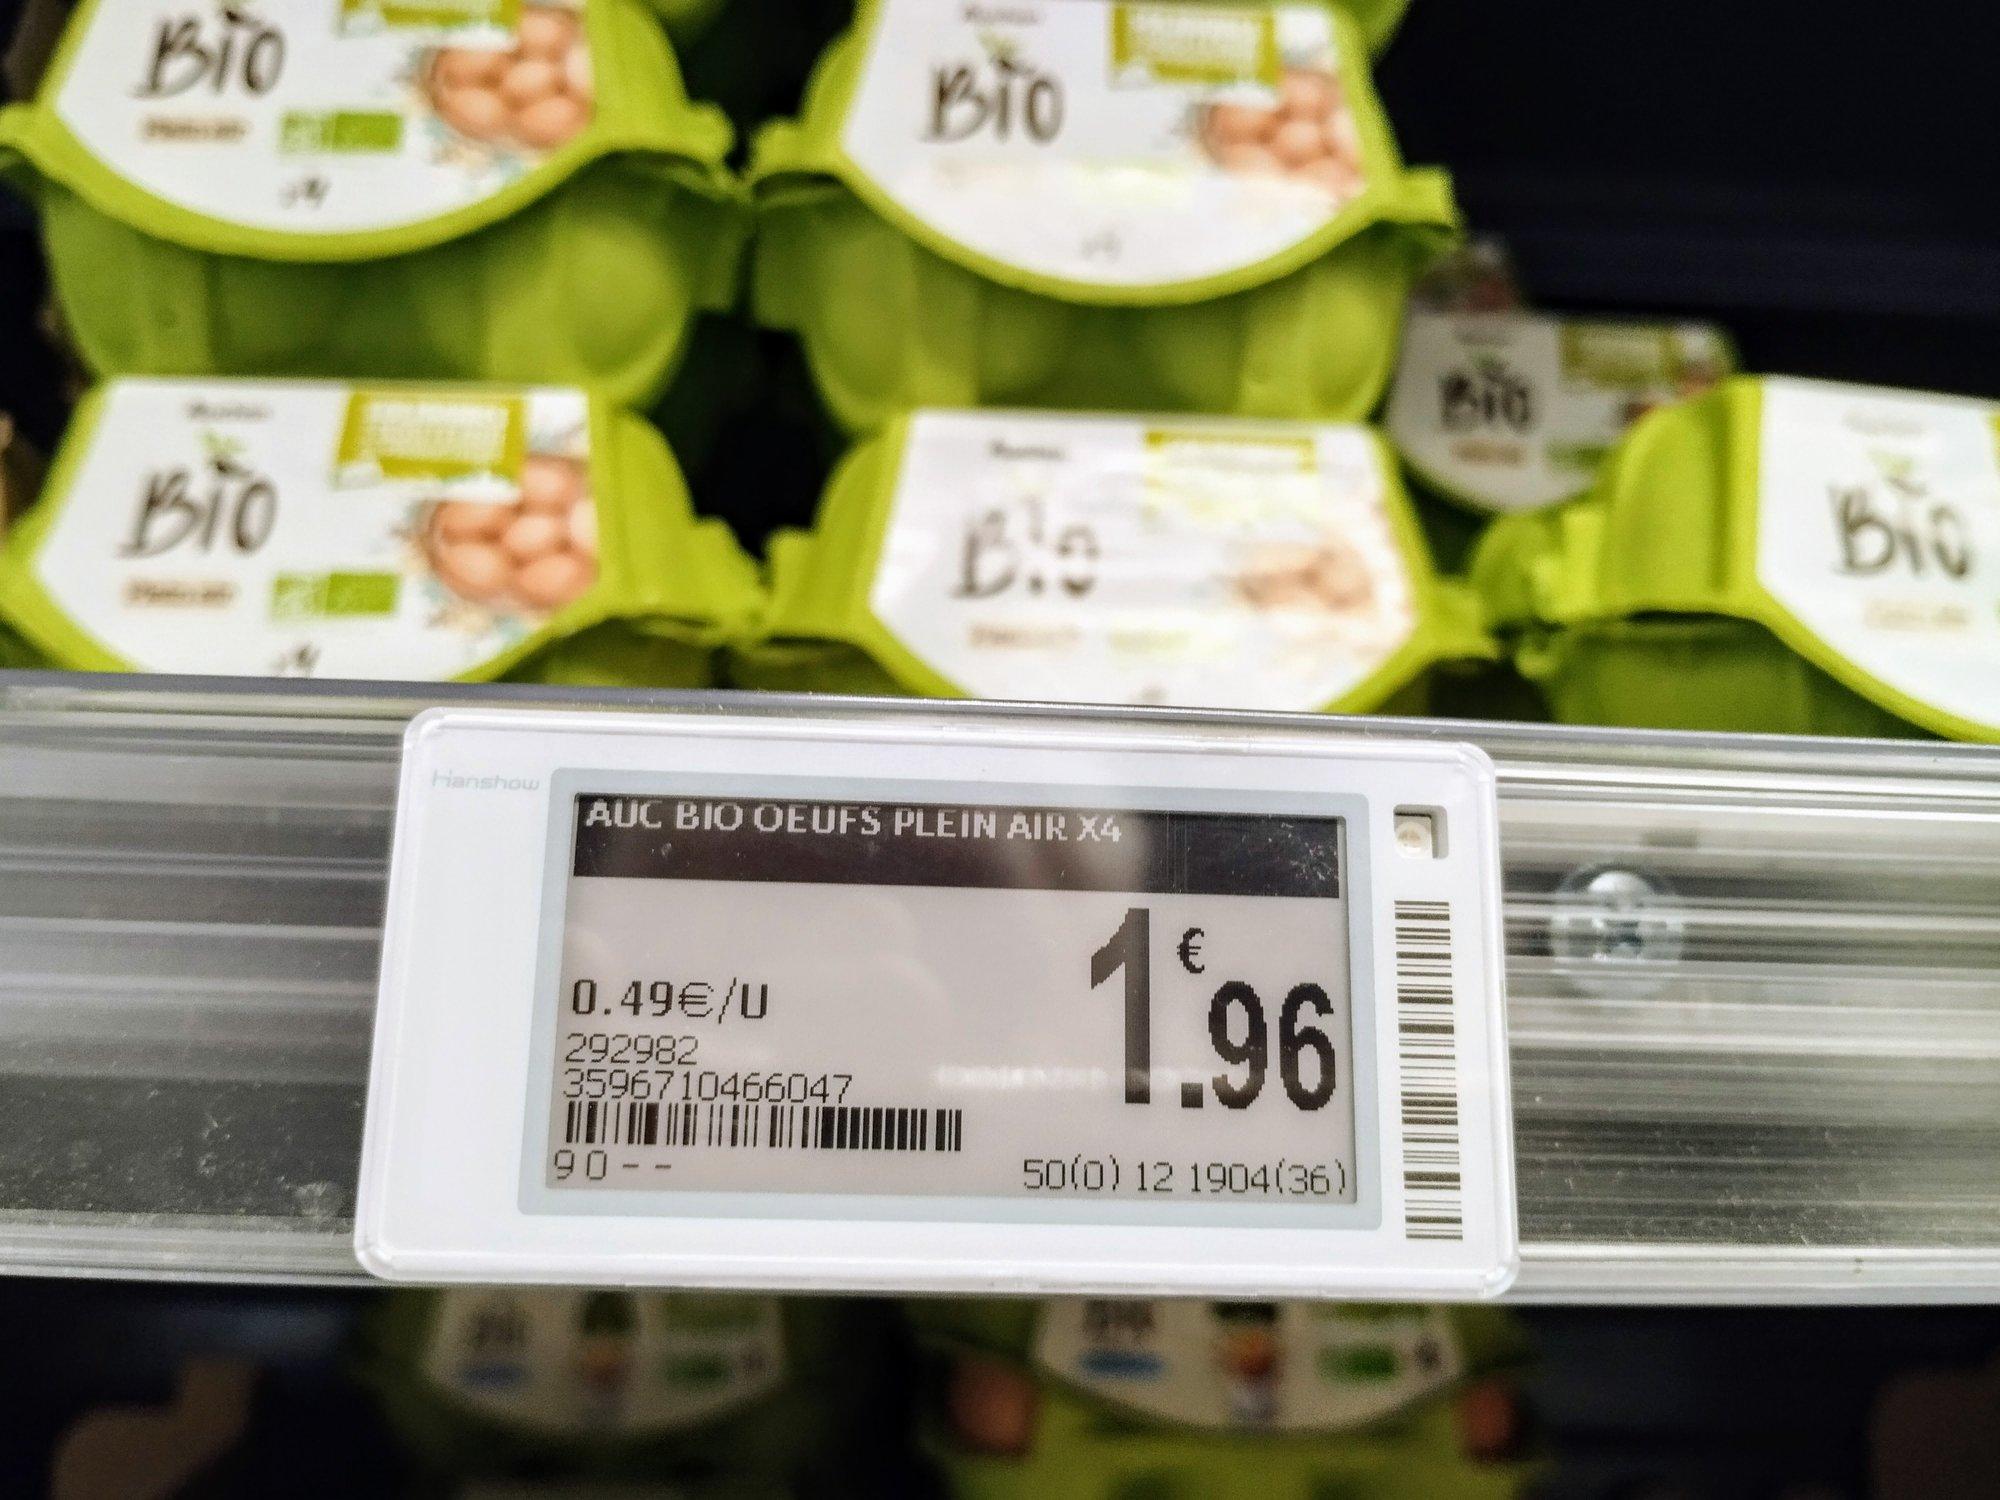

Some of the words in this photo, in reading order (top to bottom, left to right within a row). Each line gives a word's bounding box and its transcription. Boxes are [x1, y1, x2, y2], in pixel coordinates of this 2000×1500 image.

[432, 769, 541, 791] Hanshow
[585, 798, 662, 829] AUC
[674, 802, 744, 831] BIO
[753, 803, 882, 835] OEUFS
[894, 807, 997, 840] PLEIN
[1006, 812, 1068, 842] AIR
[1076, 814, 1122, 843] X4
[571, 976, 769, 1024] 0.49€/U
[565, 1032, 699, 1065] 292982
[562, 1068, 853, 1103] 3596710466047
[1023, 1154, 1119, 1191] 50(0)
[1137, 1161, 1173, 1192] 12
